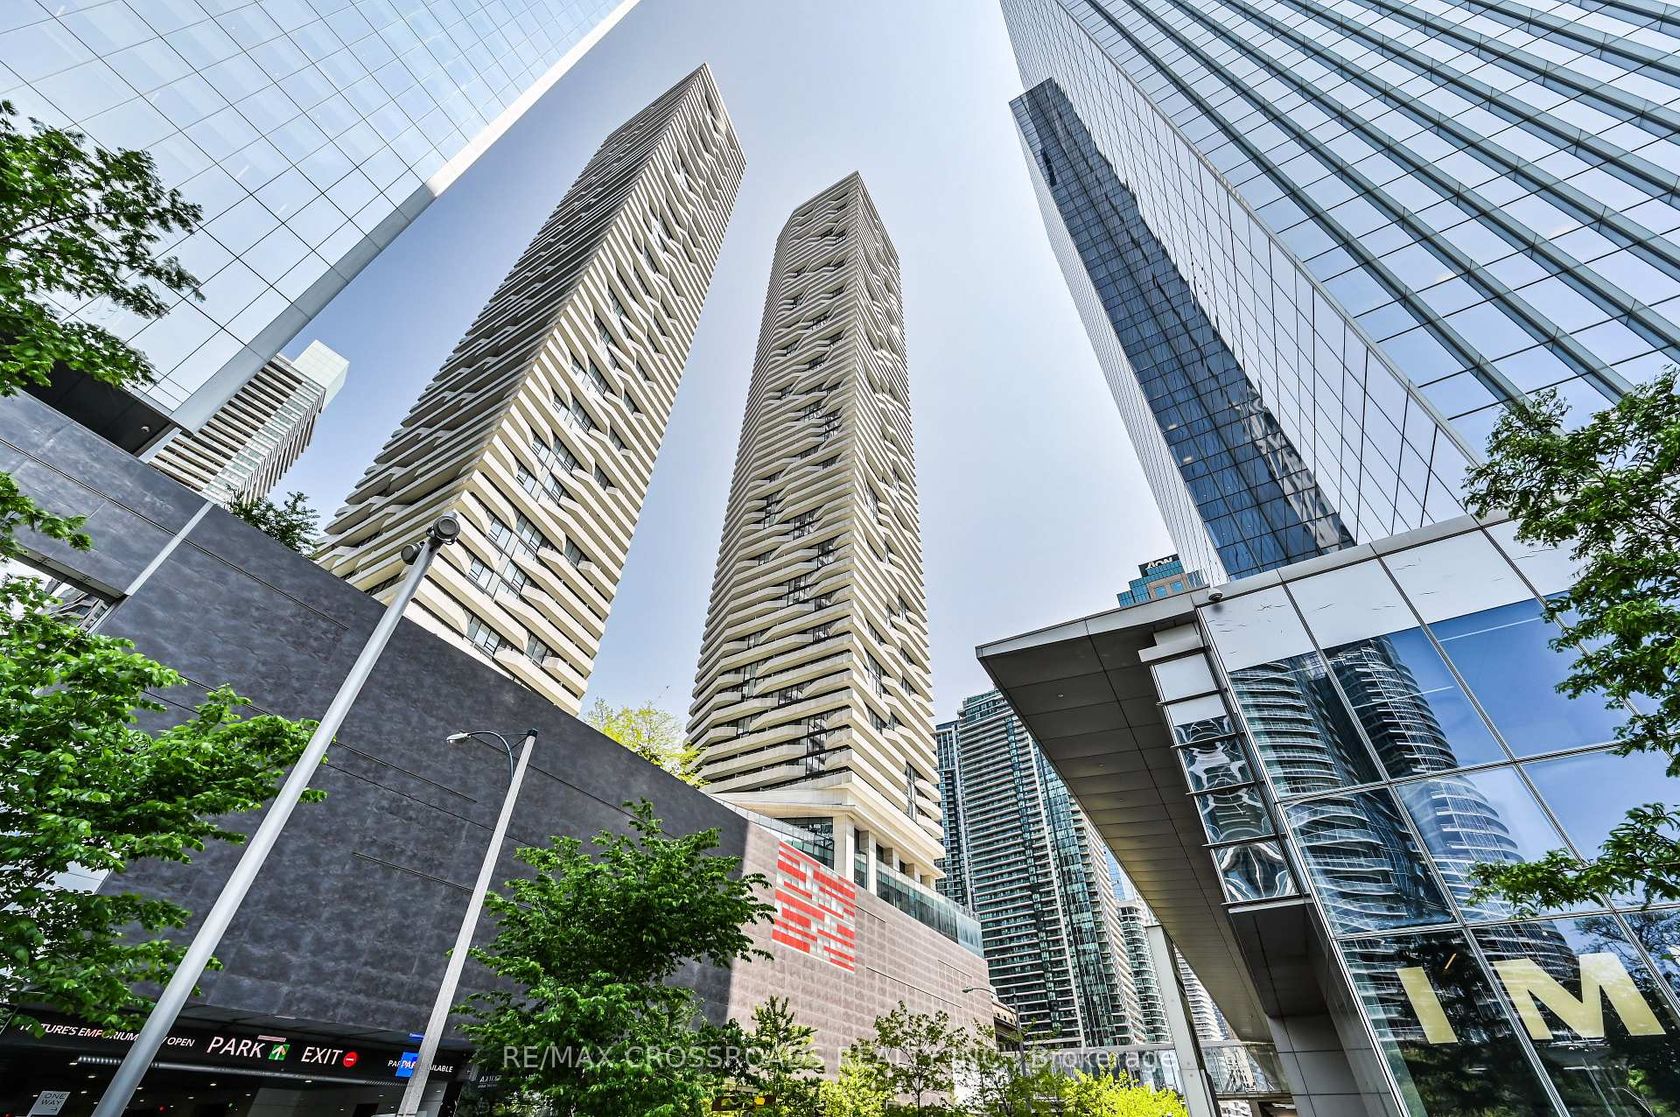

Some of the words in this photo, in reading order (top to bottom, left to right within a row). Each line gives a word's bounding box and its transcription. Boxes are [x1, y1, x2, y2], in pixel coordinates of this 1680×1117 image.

[167, 1036, 195, 1047] OPEN
[206, 1036, 265, 1059] PARK
[300, 1046, 343, 1066] EXIT
